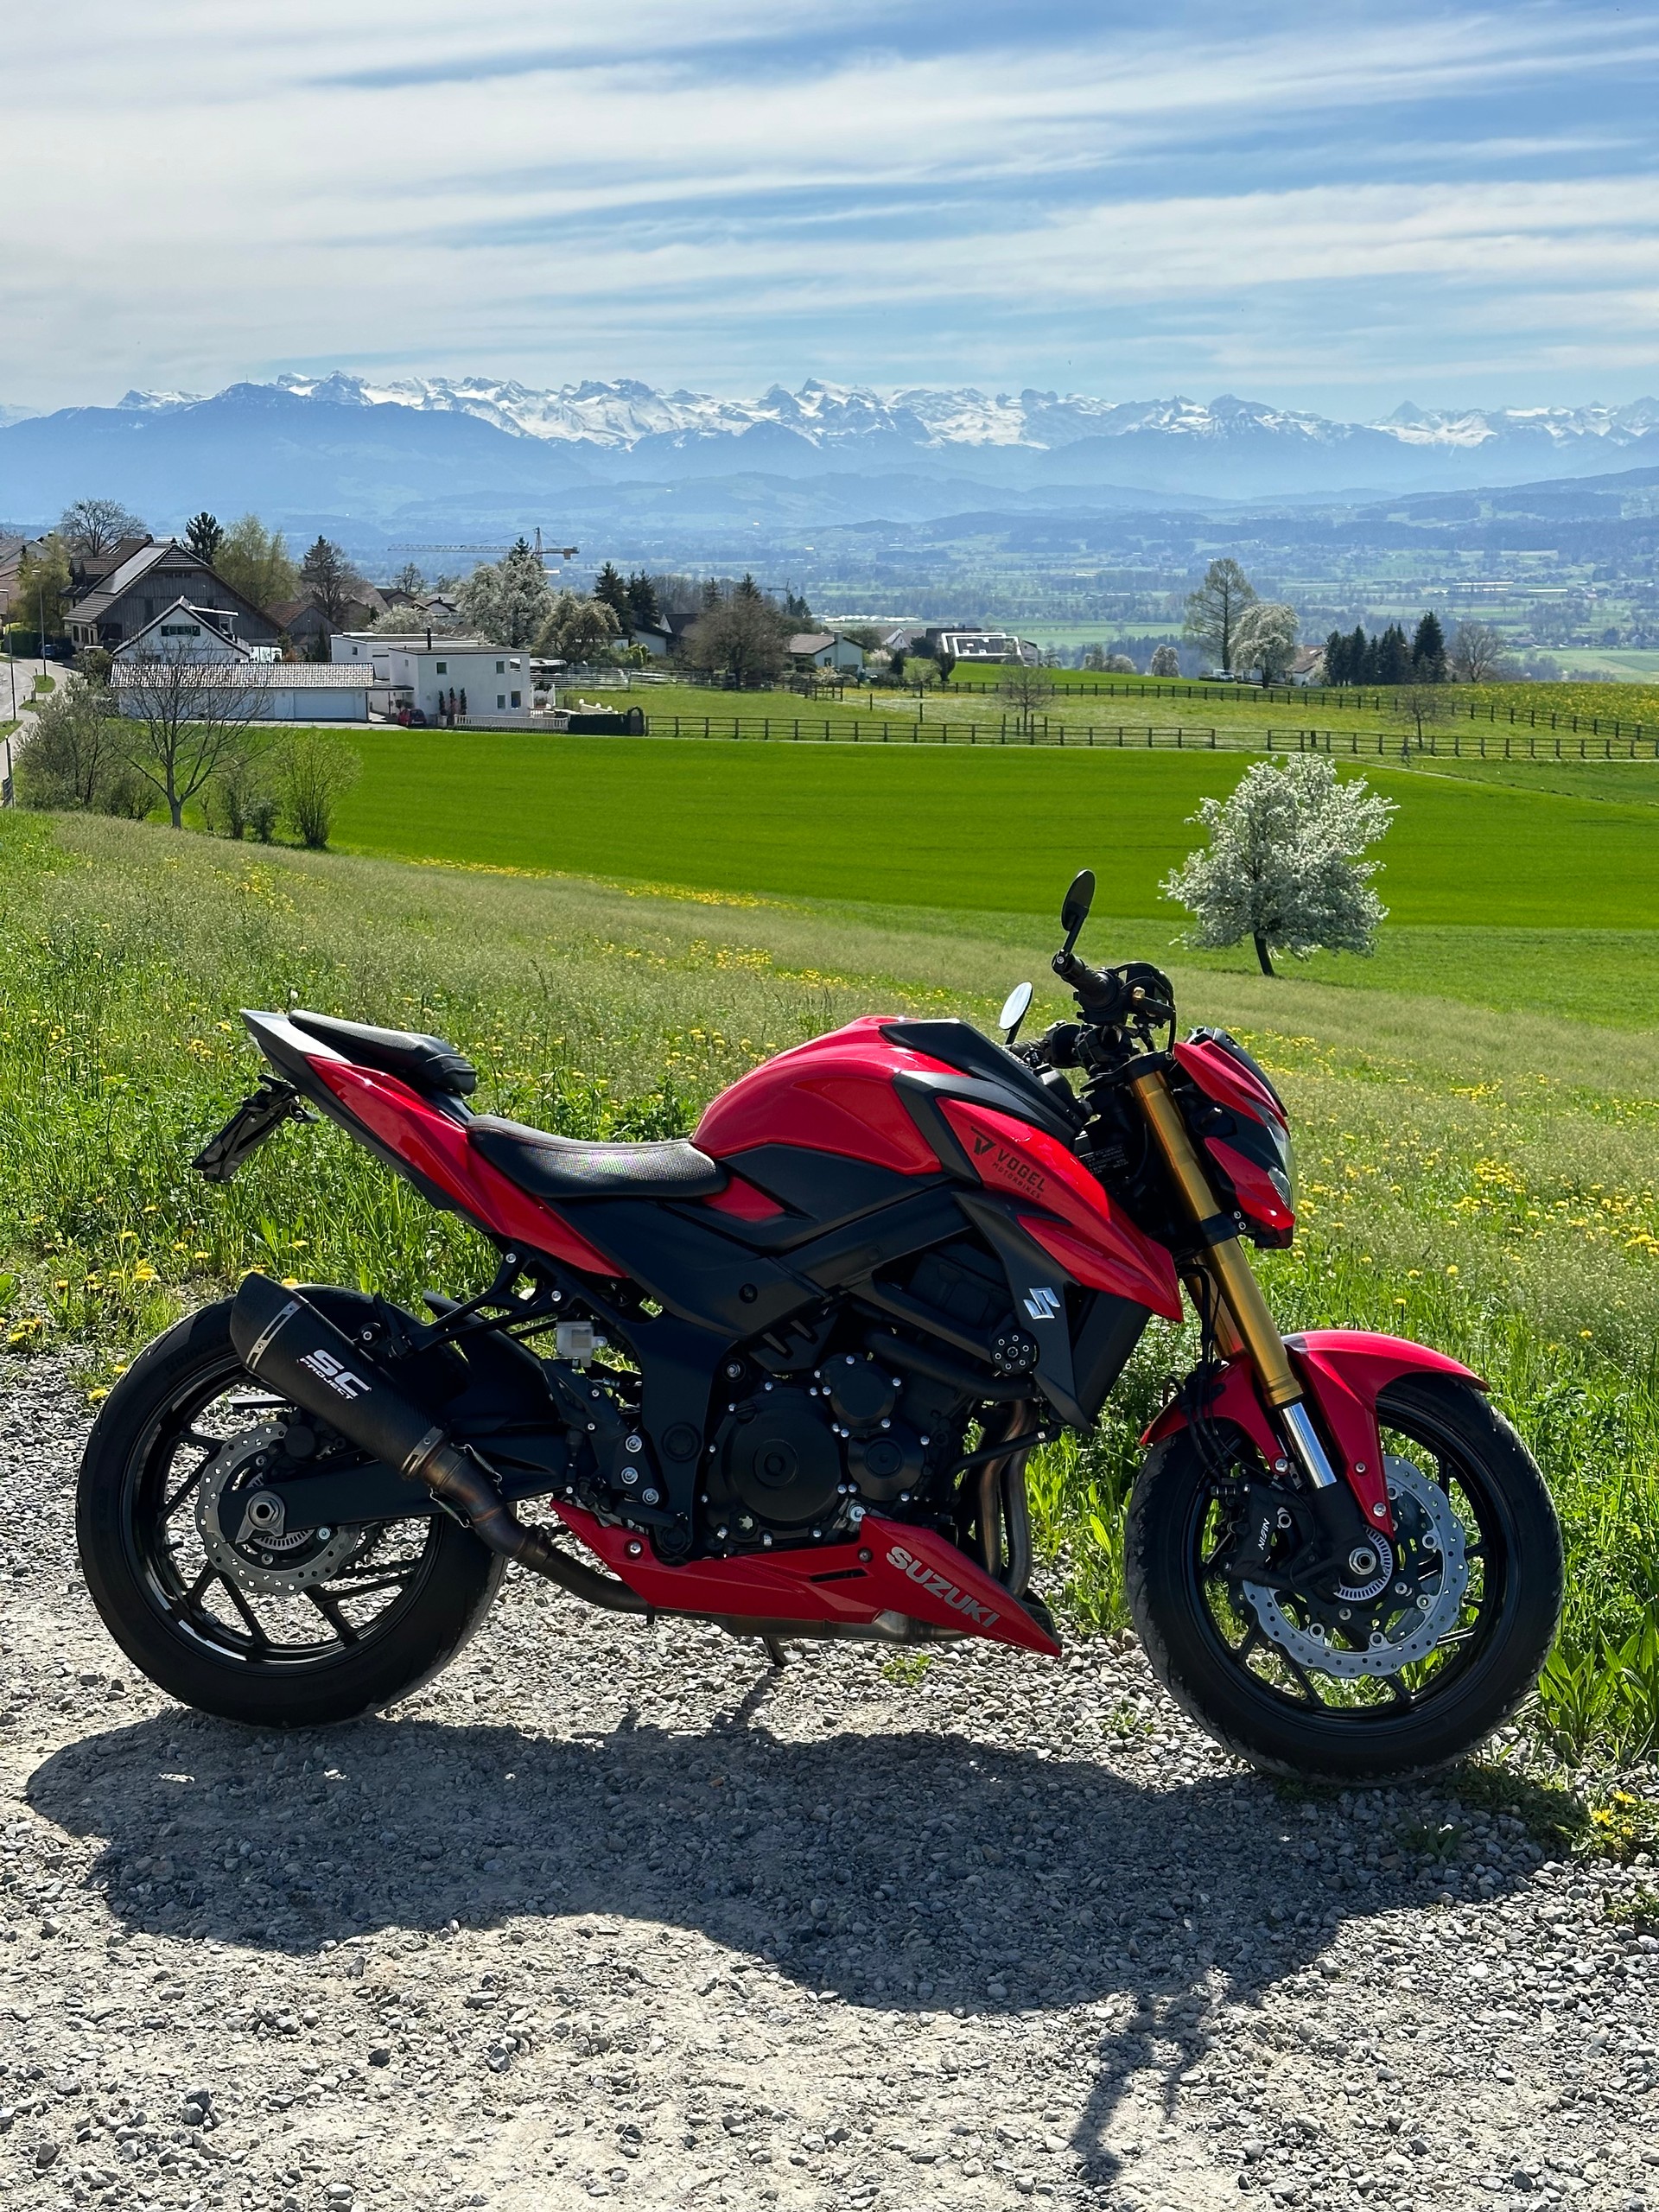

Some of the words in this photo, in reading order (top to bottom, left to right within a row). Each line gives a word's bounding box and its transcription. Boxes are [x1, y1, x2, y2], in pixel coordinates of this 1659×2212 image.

[992, 1162, 1040, 1199] MOTORBIKES
[998, 1149, 1046, 1192] VOGEL
[299, 1357, 354, 1400] PROJECT
[305, 1349, 372, 1397] SC
[886, 1546, 1001, 1628] SUZUKI
